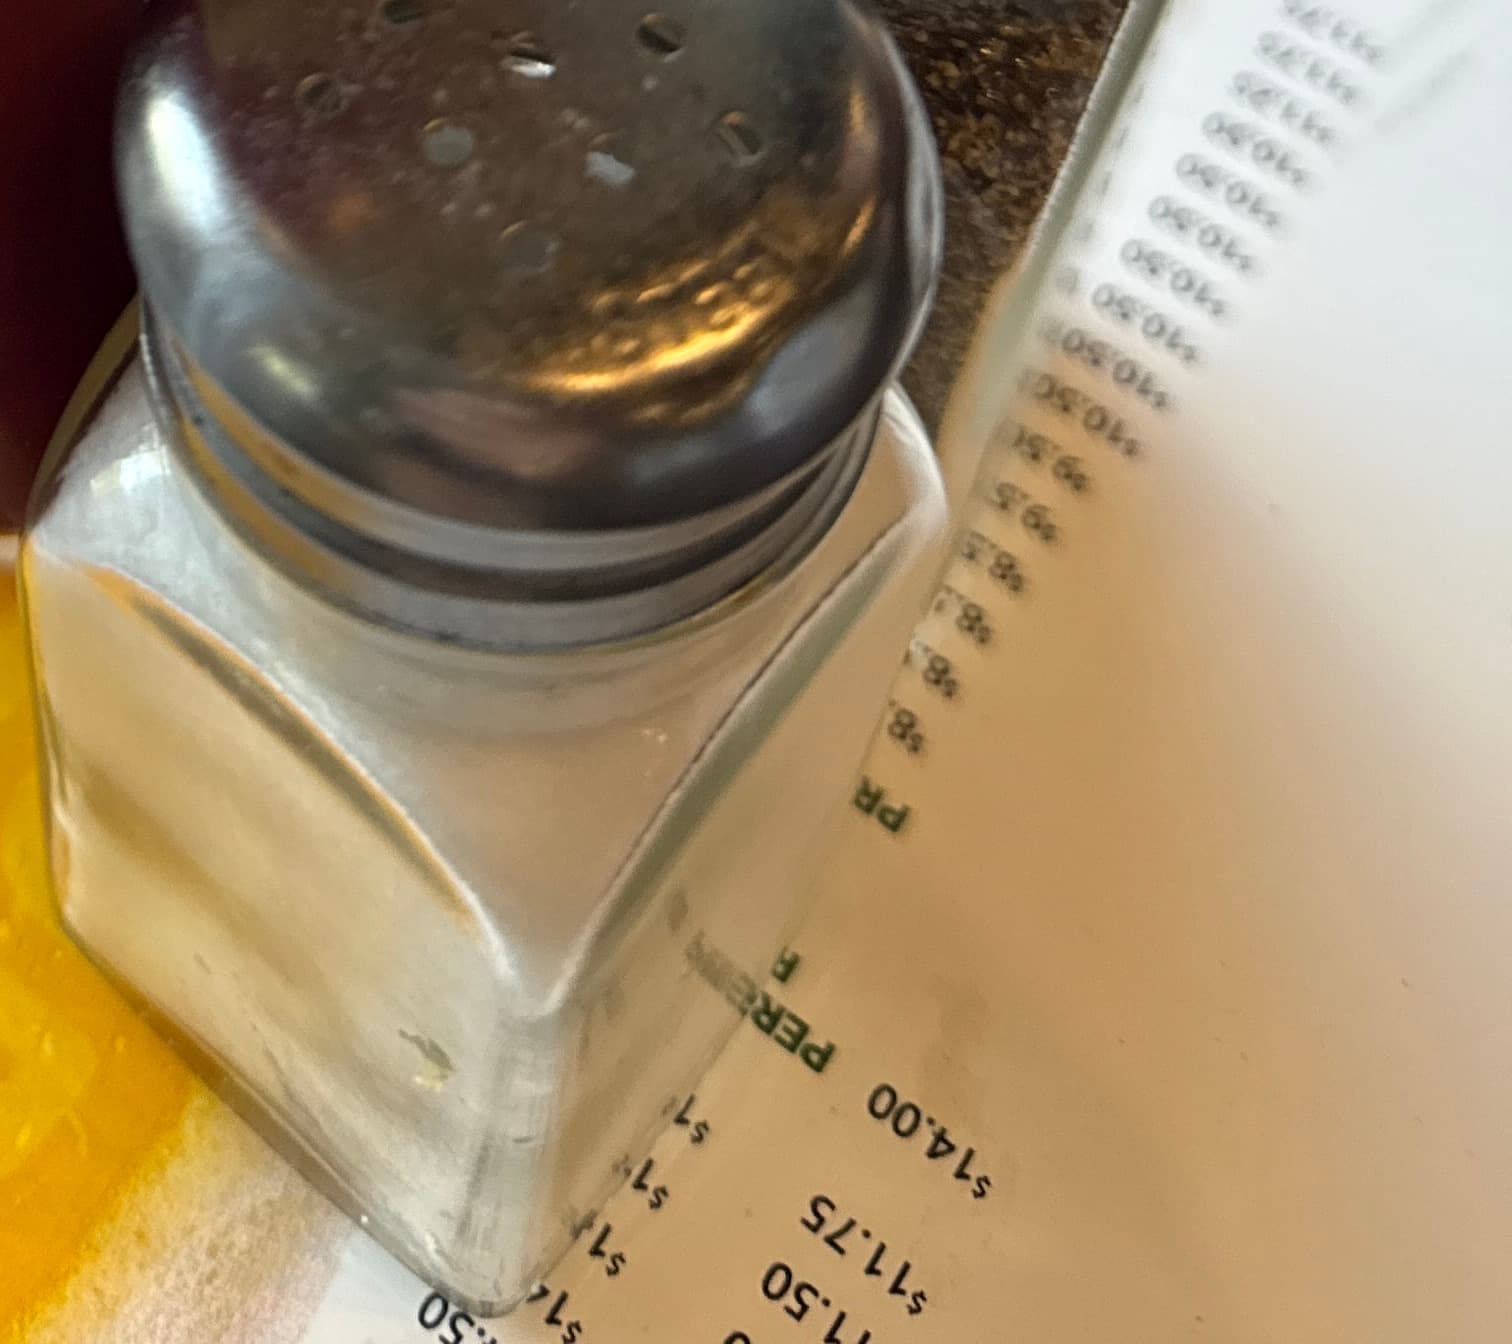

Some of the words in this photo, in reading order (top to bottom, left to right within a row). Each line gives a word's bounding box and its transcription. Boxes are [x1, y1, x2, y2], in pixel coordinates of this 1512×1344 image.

[1118, 236, 1230, 321] $10.50
[1090, 280, 1201, 367] $10.50
[1056, 324, 1173, 414] $10.50
[853, 775, 915, 835] PR
[866, 1081, 993, 1200] $14.00
[798, 1192, 930, 1316] $11.75
